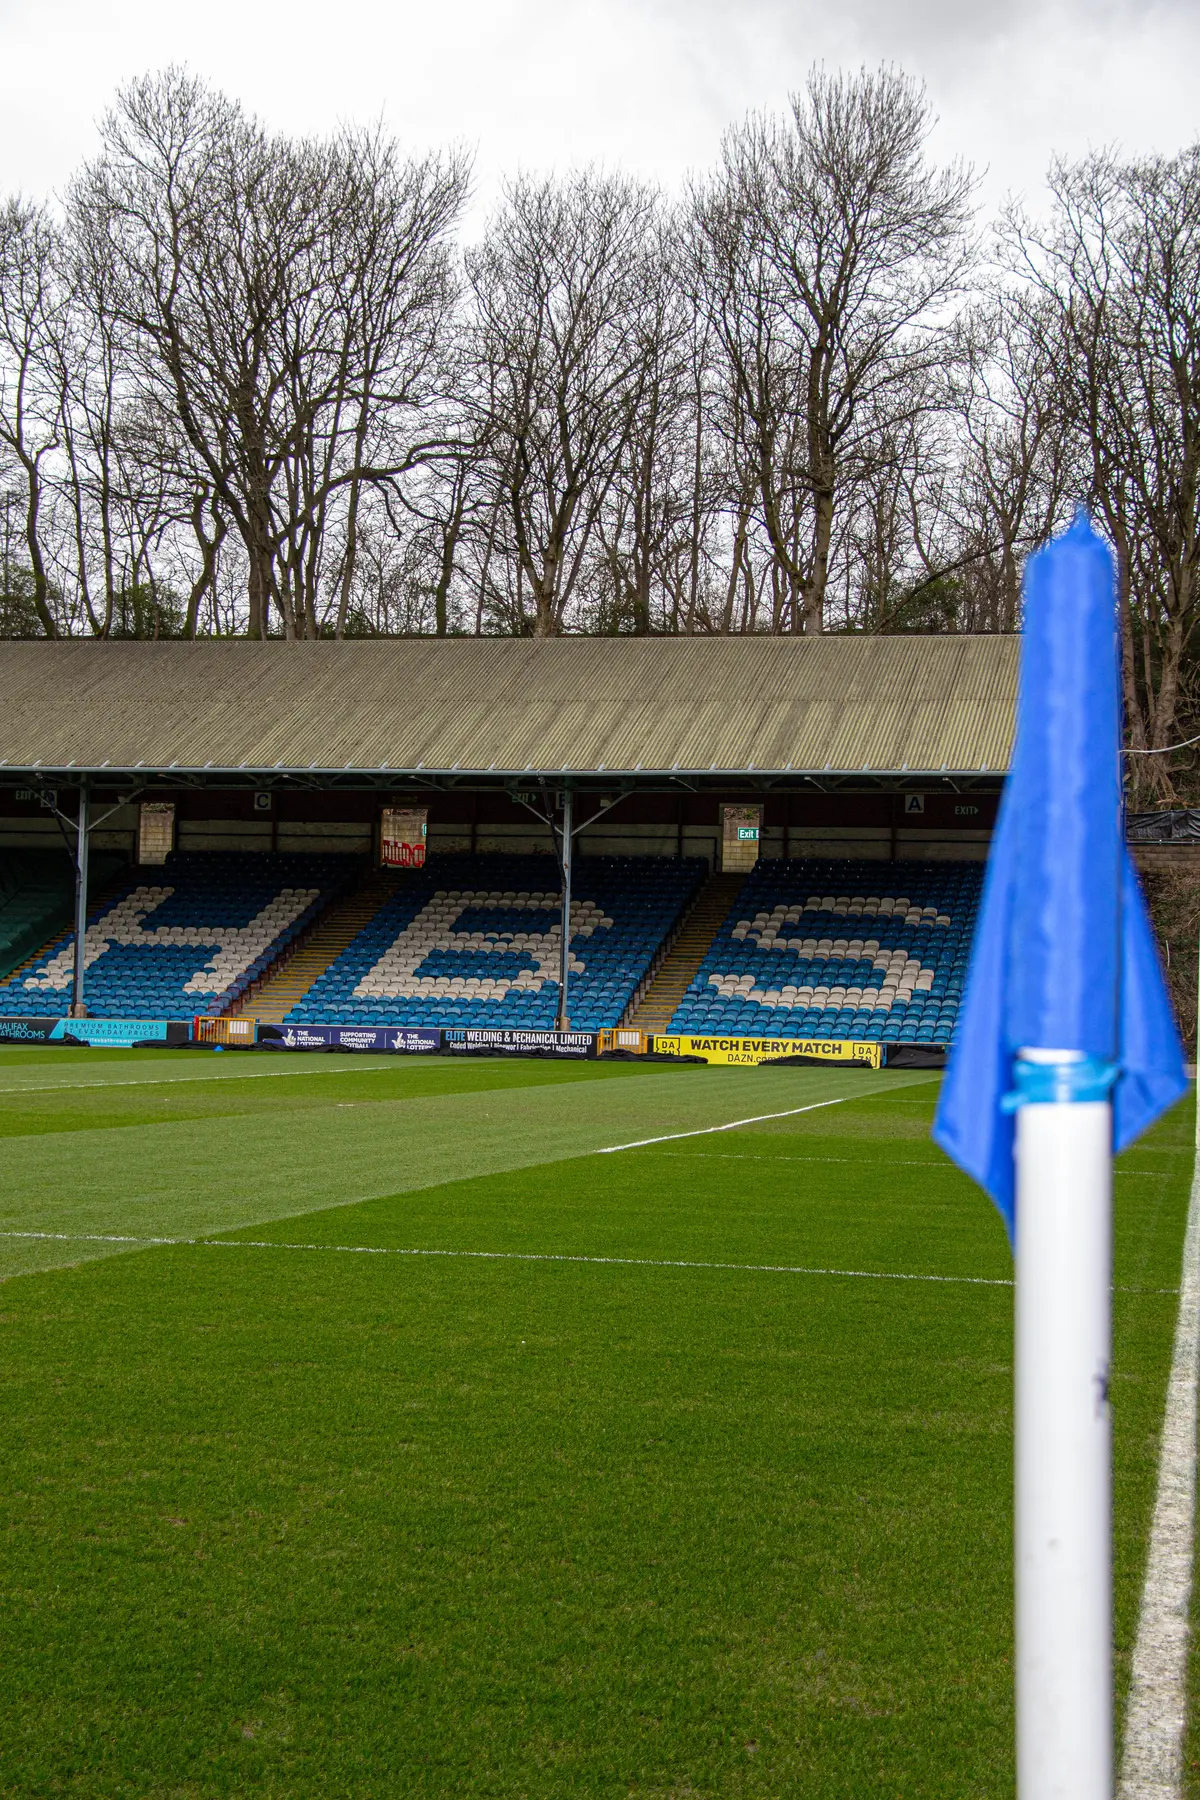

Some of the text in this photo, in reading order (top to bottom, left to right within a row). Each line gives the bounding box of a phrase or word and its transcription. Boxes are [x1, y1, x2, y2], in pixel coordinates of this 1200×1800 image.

[16, 790, 31, 800] EXIT
[256, 794, 269, 808] C
[908, 796, 921, 810] A
[954, 806, 974, 815] EXIT
[739, 830, 754, 838] Exit
[78, 1028, 122, 1036] EVERYDAY
[107, 1023, 160, 1031] BATHROOMS
[0, 1030, 46, 1039] ATHROOMS
[445, 1031, 465, 1041] ELITE
[467, 1031, 503, 1042] WELDING
[504, 1032, 510, 1042] &
[560, 1034, 592, 1045] LIMITED
[449, 1041, 467, 1049] Coded
[556, 1045, 587, 1053] Mechanical
[690, 1039, 842, 1055] WATCH EVERY MATCH
